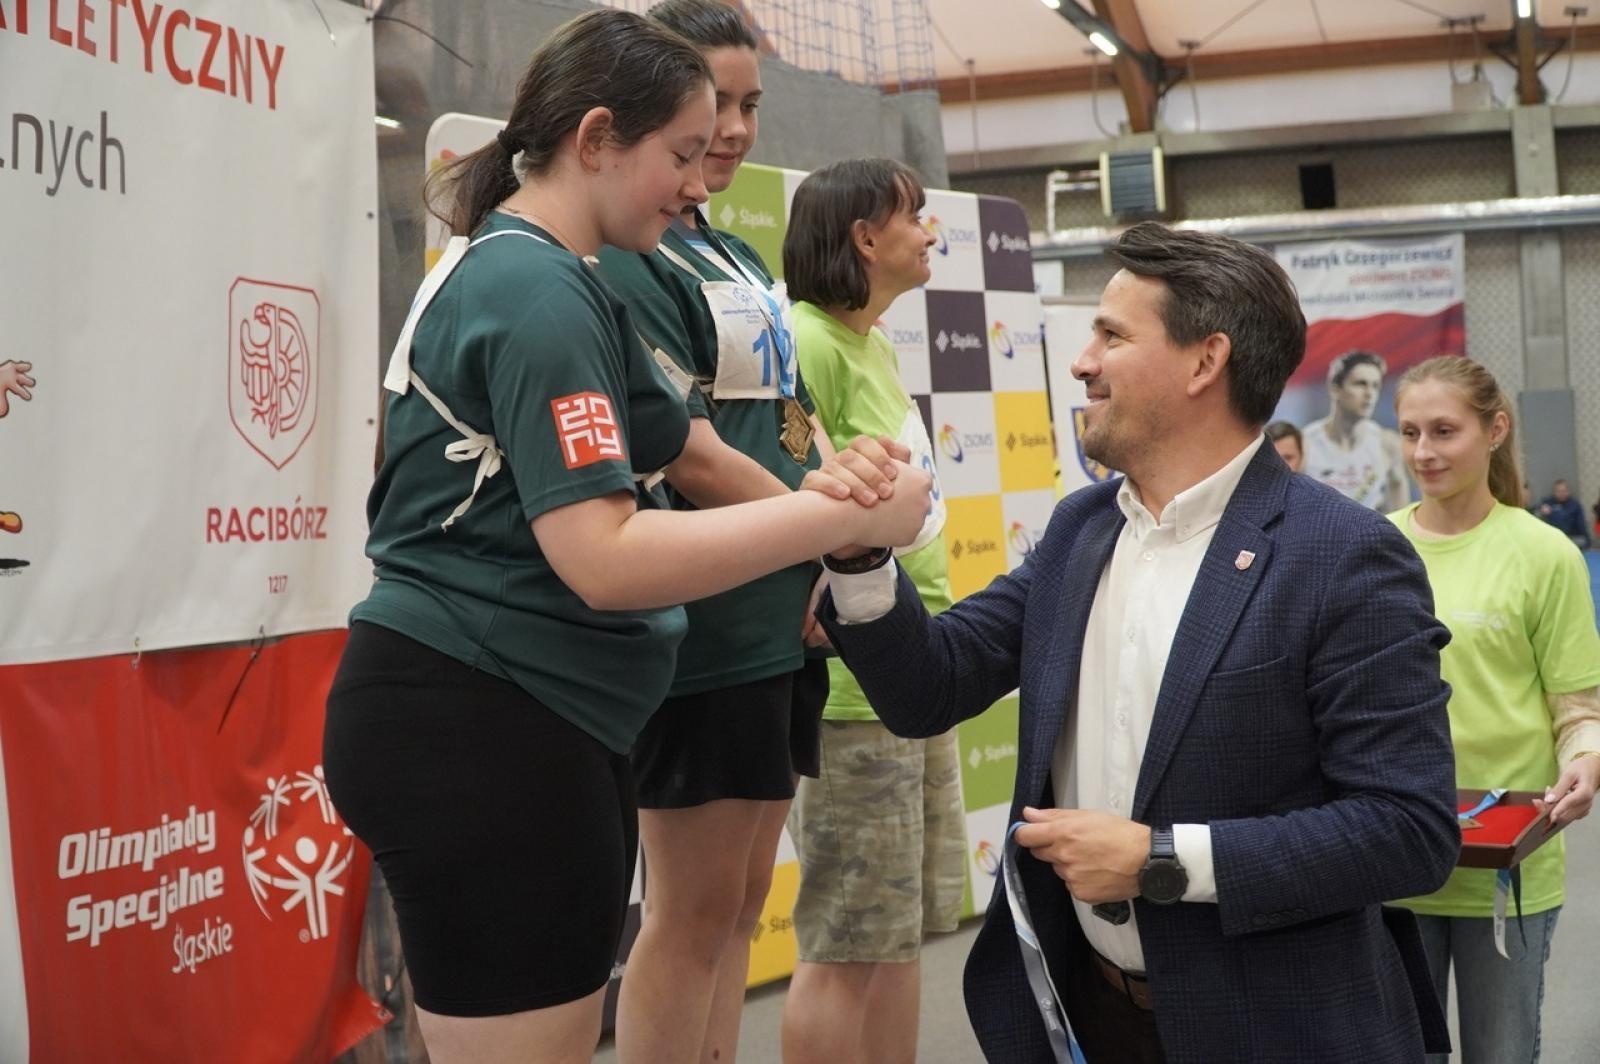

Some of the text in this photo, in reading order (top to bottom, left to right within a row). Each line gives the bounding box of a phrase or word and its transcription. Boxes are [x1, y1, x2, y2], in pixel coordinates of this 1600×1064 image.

[0, 0, 285, 110] LETYCZNY
[0, 111, 126, 197] nych
[206, 495, 328, 543] RACIBÓRZ
[268, 575, 288, 593] 1217
[58, 805, 216, 880] Olimpiady
[66, 866, 225, 948] Specjalne
